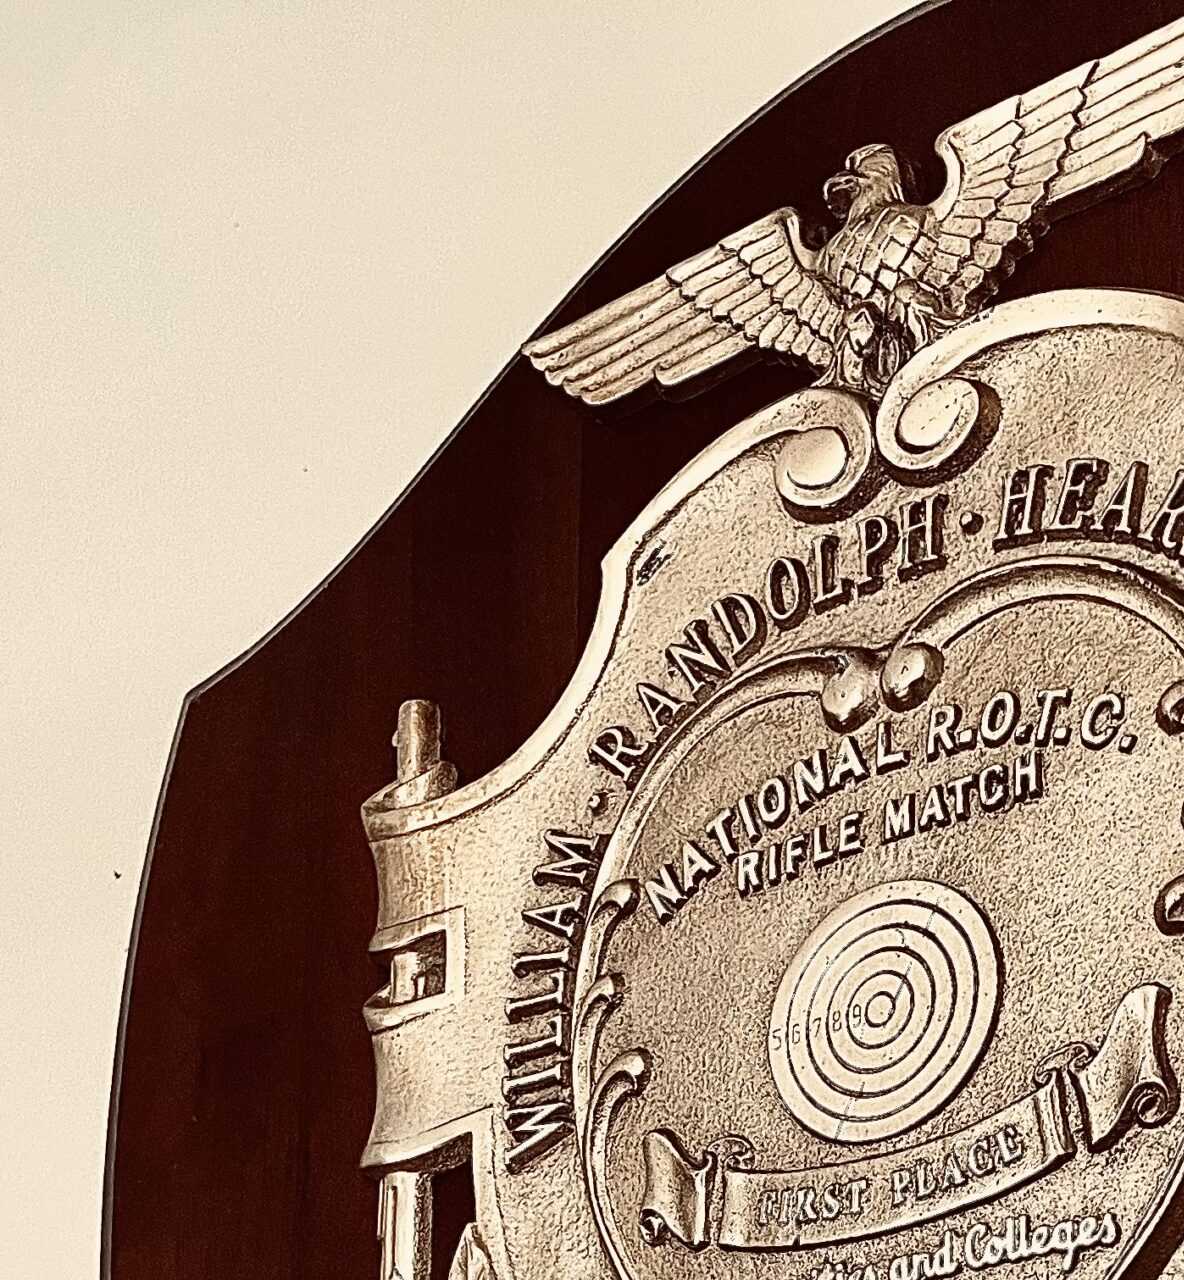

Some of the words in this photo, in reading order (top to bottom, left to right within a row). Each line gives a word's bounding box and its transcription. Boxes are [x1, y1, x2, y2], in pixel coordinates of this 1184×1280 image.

[501, 828, 600, 1173] WILLIAM
[588, 491, 951, 788] RANDOLPH
[643, 722, 910, 925] NATIONAL
[926, 688, 1138, 760] R.O.T.C.
[734, 811, 866, 896] RIFLE
[883, 751, 1044, 845] MATCH
[757, 1177, 869, 1225] FIRST
[893, 1123, 1028, 1202] PLACE
[963, 1209, 1122, 1273] Colleges
